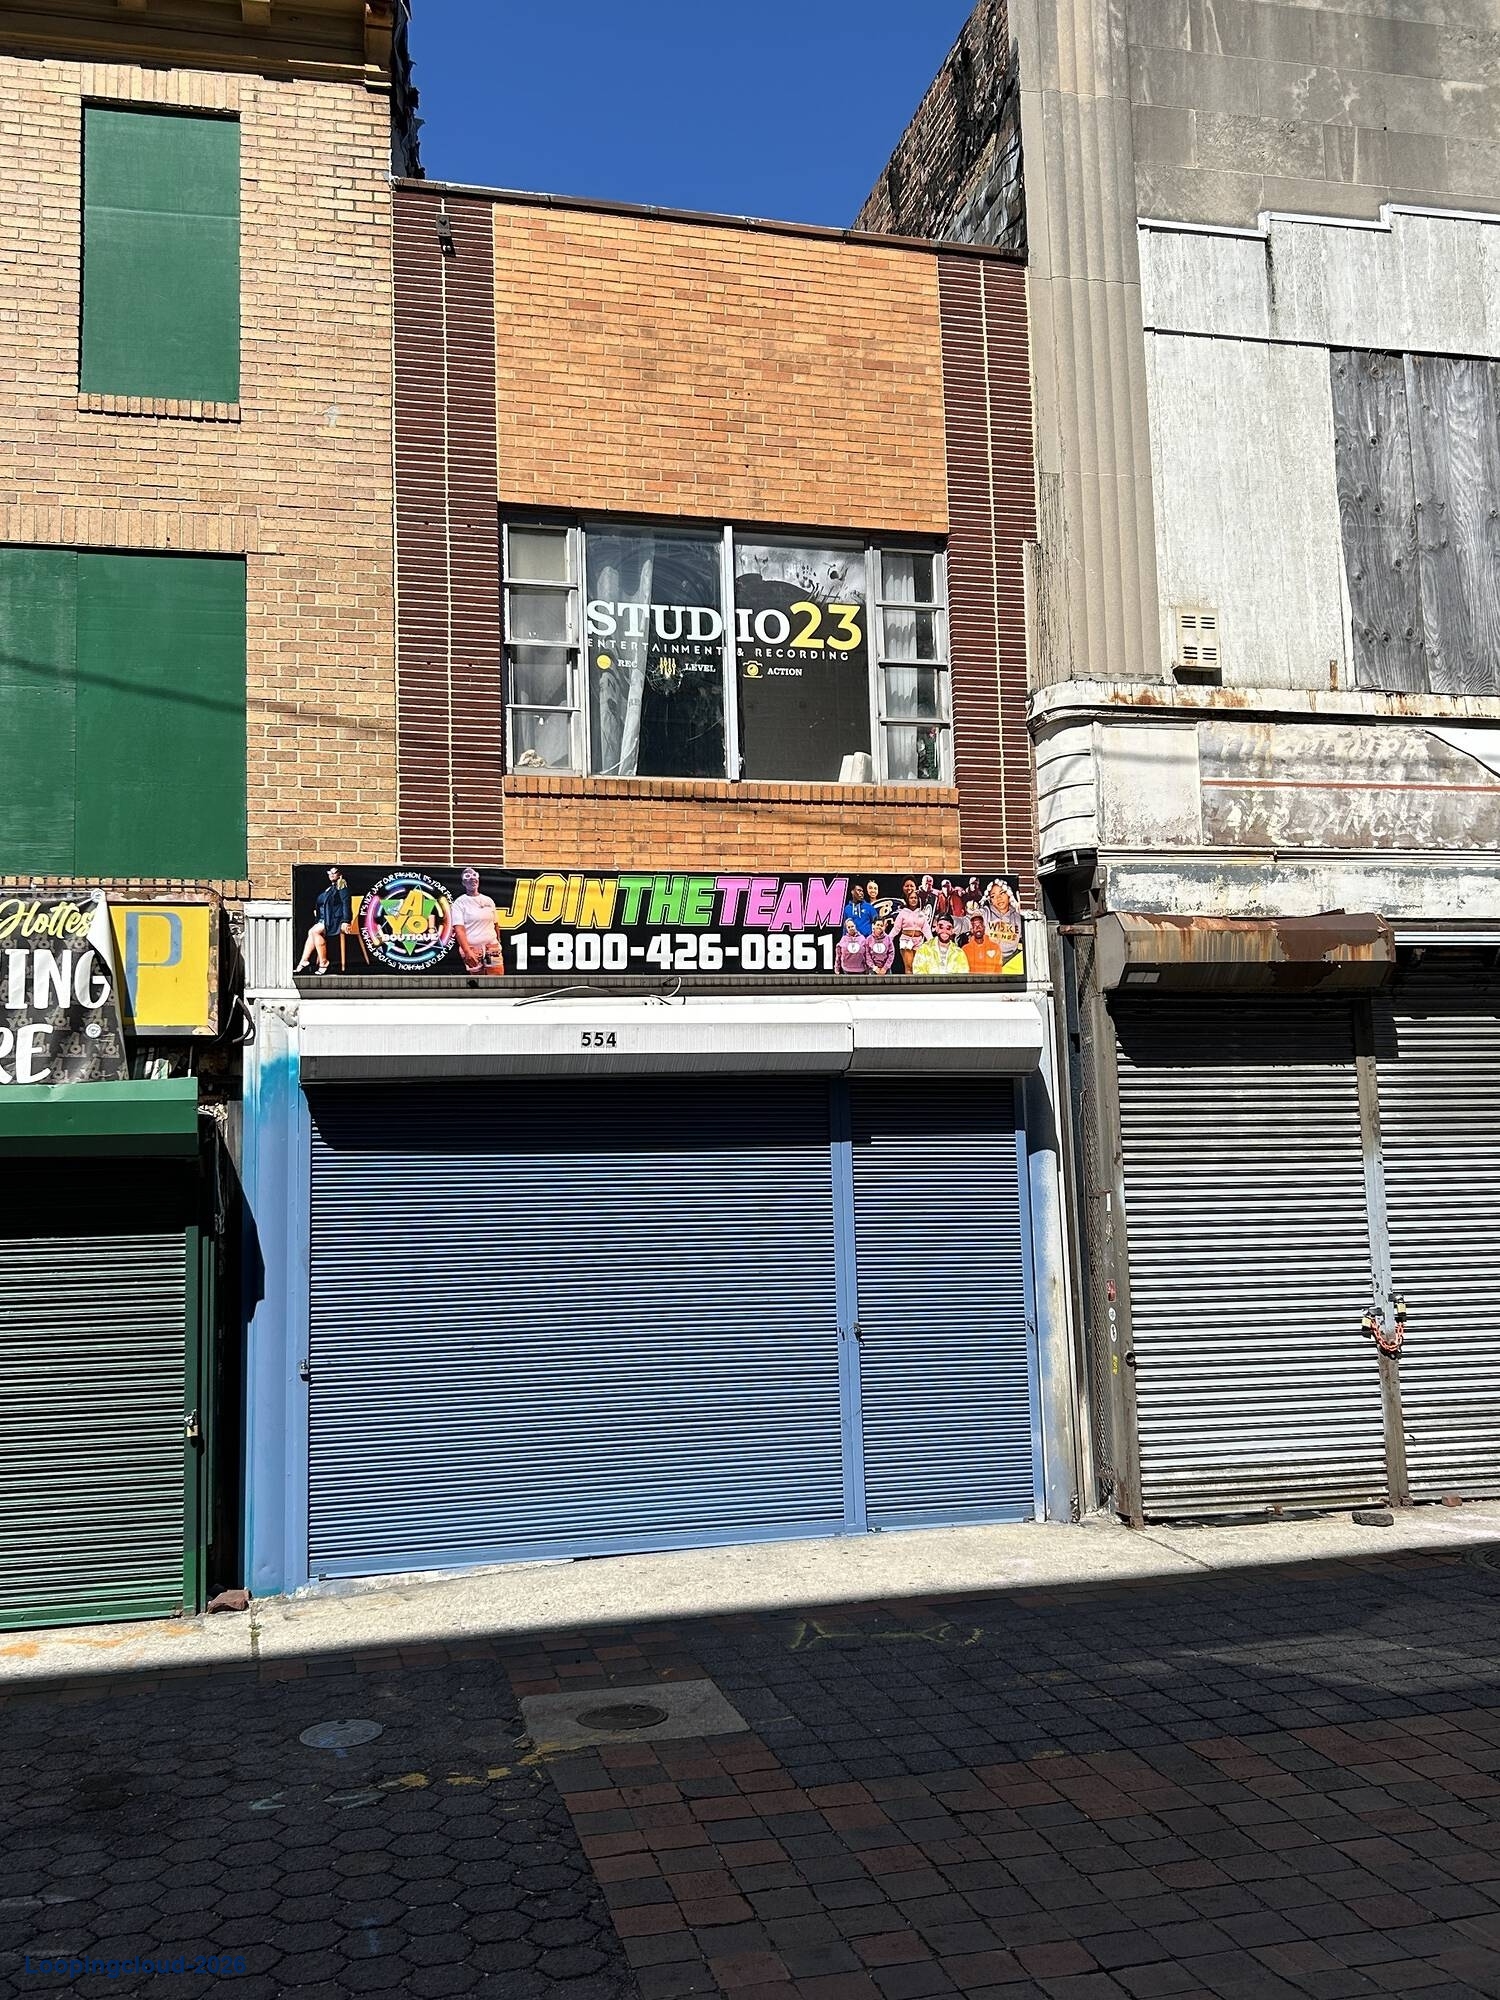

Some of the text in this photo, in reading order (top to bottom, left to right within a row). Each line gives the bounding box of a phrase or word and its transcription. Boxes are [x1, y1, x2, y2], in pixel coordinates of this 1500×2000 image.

[589, 639, 849, 661] ENTERTAINMENT & RECORDING
[618, 659, 803, 677] REC LEVEL ACTION
[382, 933, 439, 942] BOUTIQUE
[510, 932, 834, 971] 1-800-426-0861
[126, 912, 182, 1018] P
[5, 948, 112, 1010] ING
[582, 1032, 617, 1048] 554
